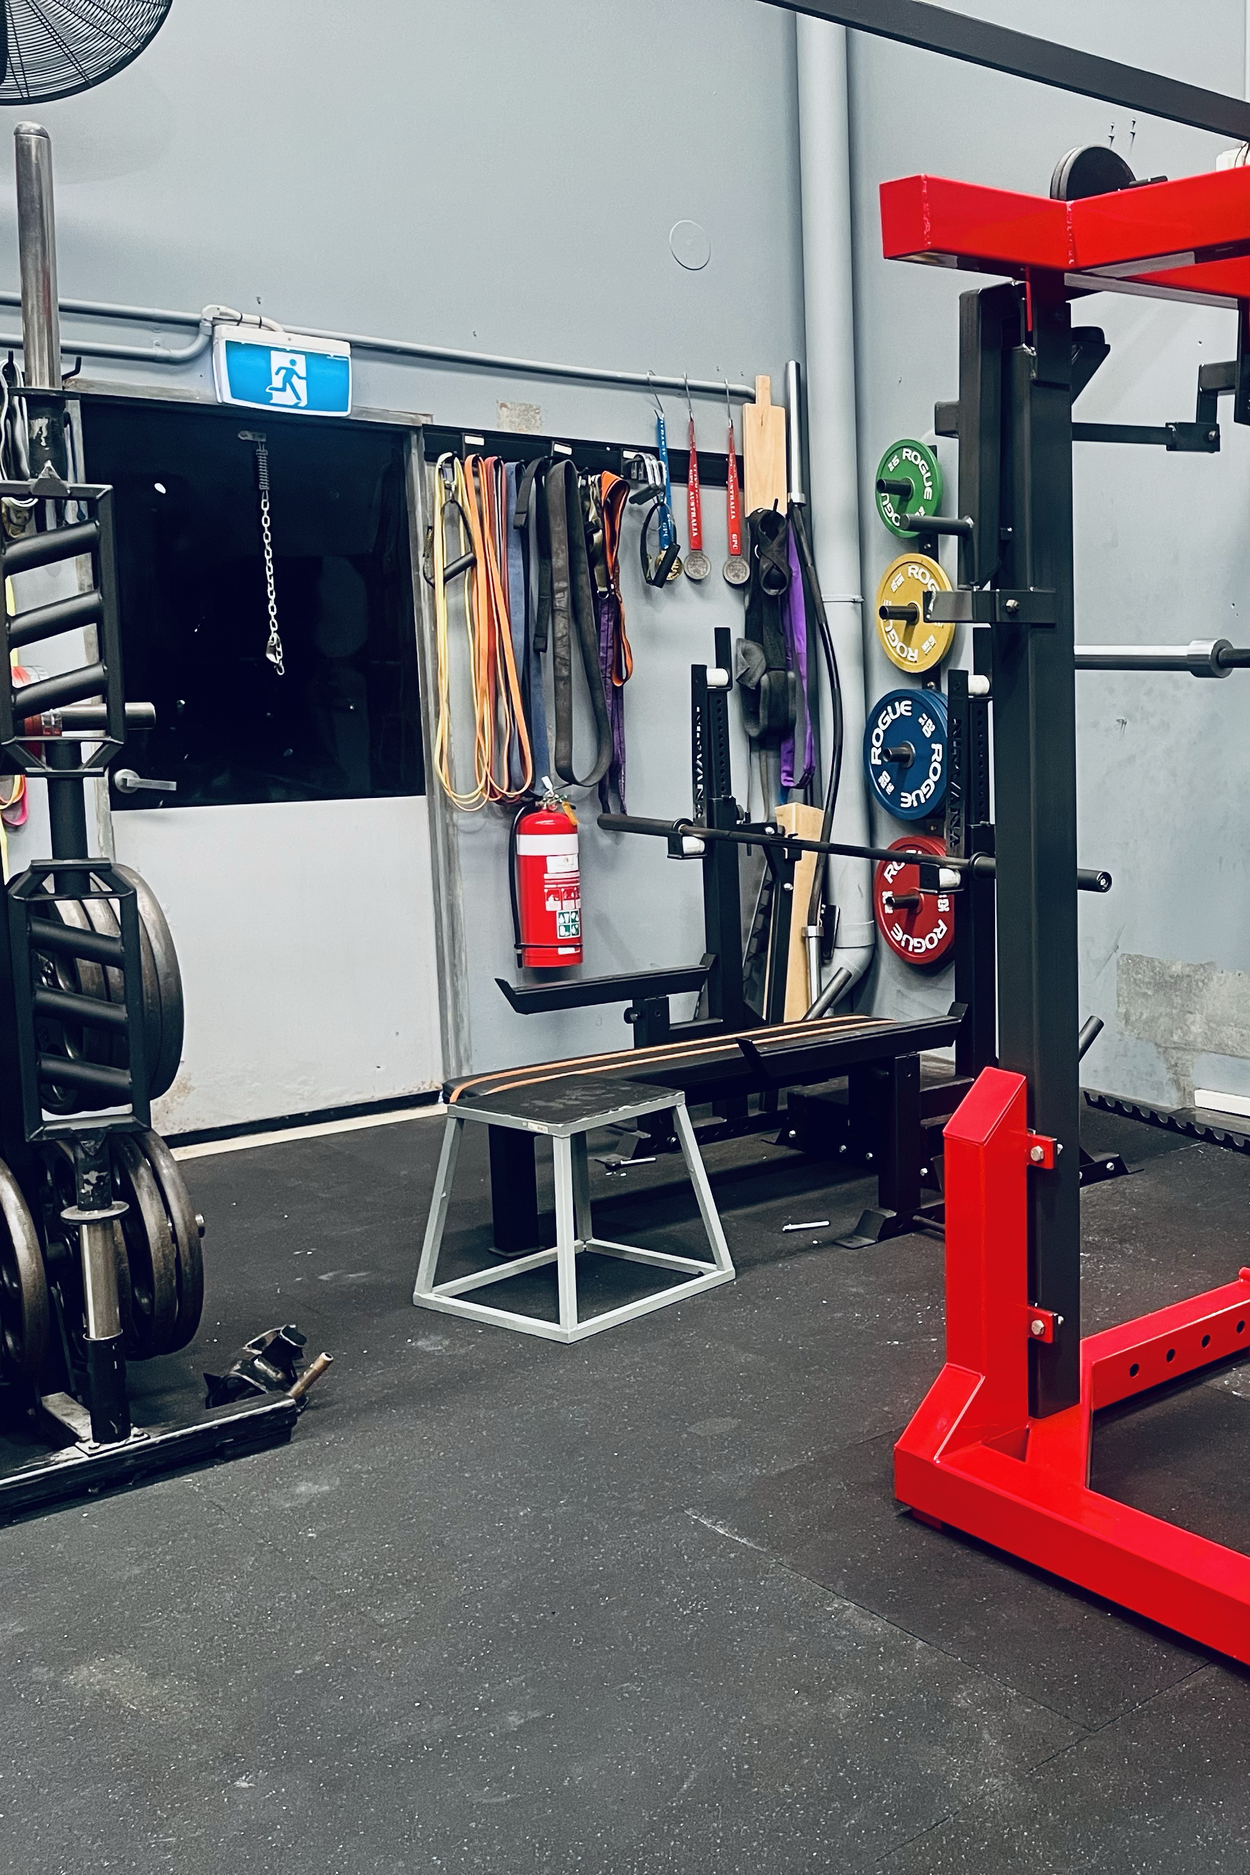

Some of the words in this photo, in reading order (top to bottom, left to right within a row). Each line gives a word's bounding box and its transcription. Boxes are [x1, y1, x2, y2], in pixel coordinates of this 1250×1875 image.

[902, 448, 933, 501] ROGUE
[689, 491, 698, 537] AUSTRALIA
[881, 493, 901, 527] OGU
[870, 700, 912, 765] ROGUE
[921, 718, 936, 738] 20
[877, 770, 891, 789] 20
[900, 743, 943, 808] ROGUE
[890, 919, 948, 953] ROGUE
